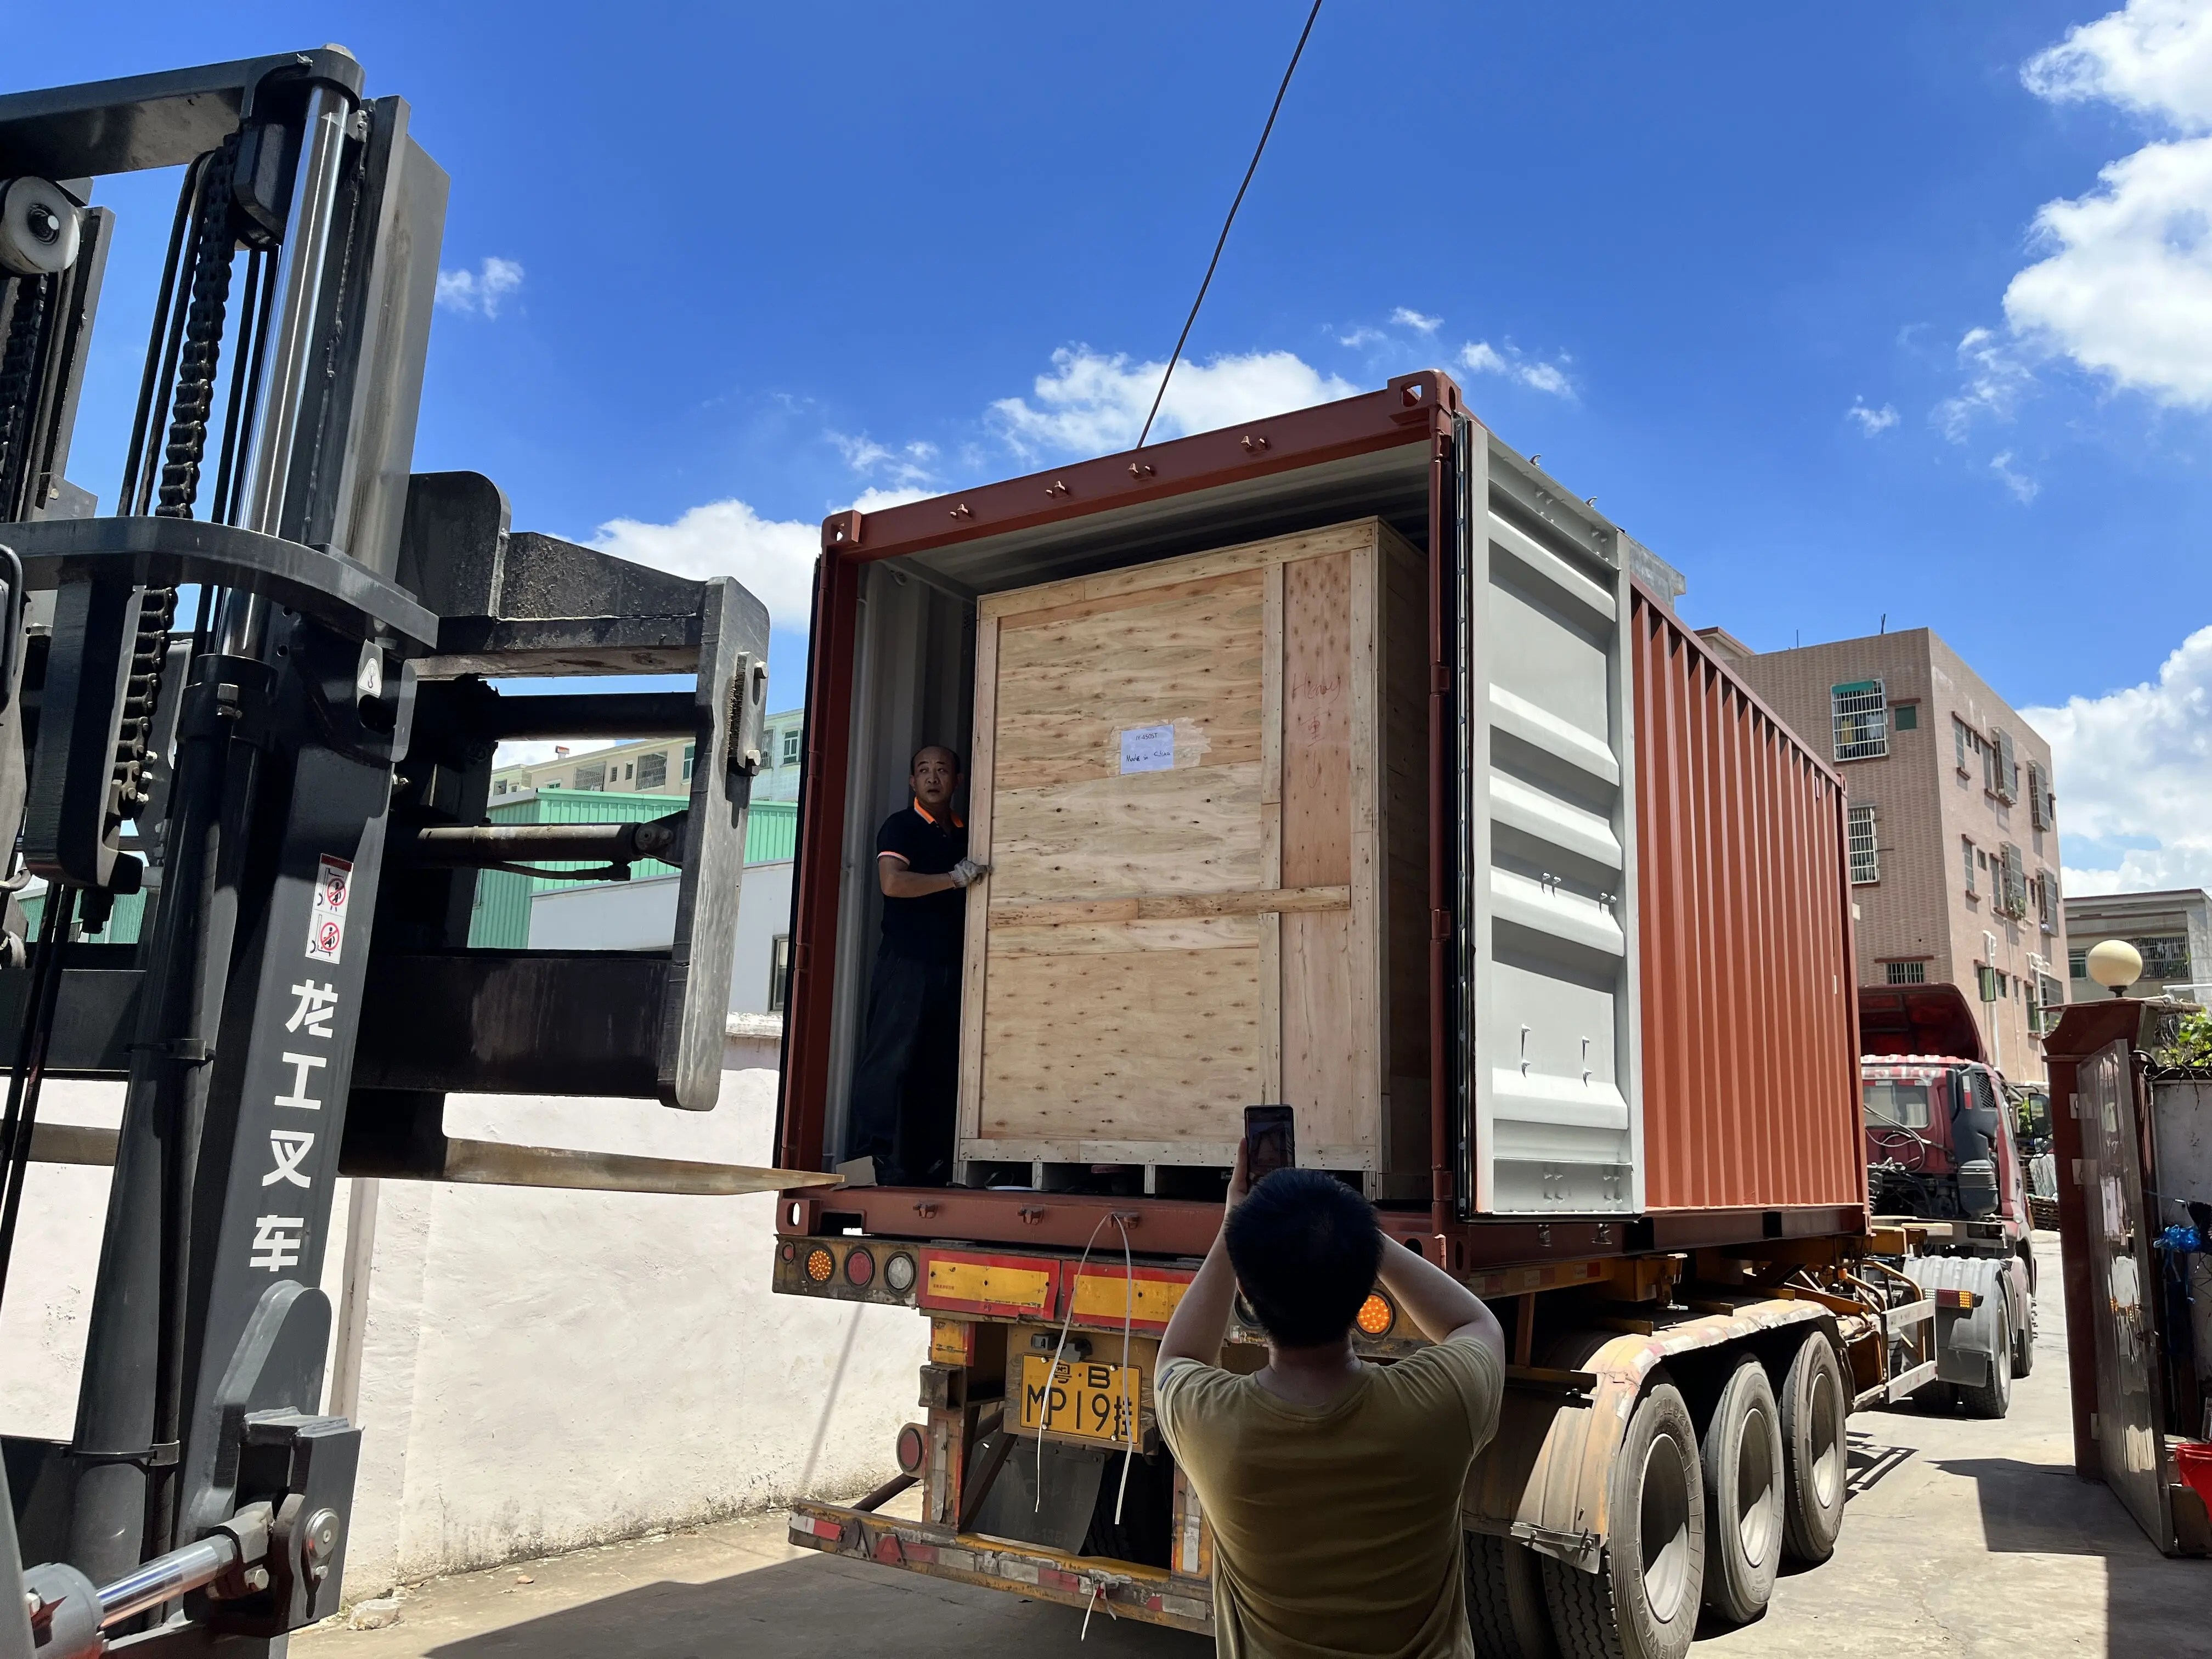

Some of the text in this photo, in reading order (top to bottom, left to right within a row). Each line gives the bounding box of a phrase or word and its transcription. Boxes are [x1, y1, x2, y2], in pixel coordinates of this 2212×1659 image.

[1291, 673, 1341, 704] Heavy
[1126, 754, 1140, 763] Made
[249, 979, 338, 1272] 龙工叉车
